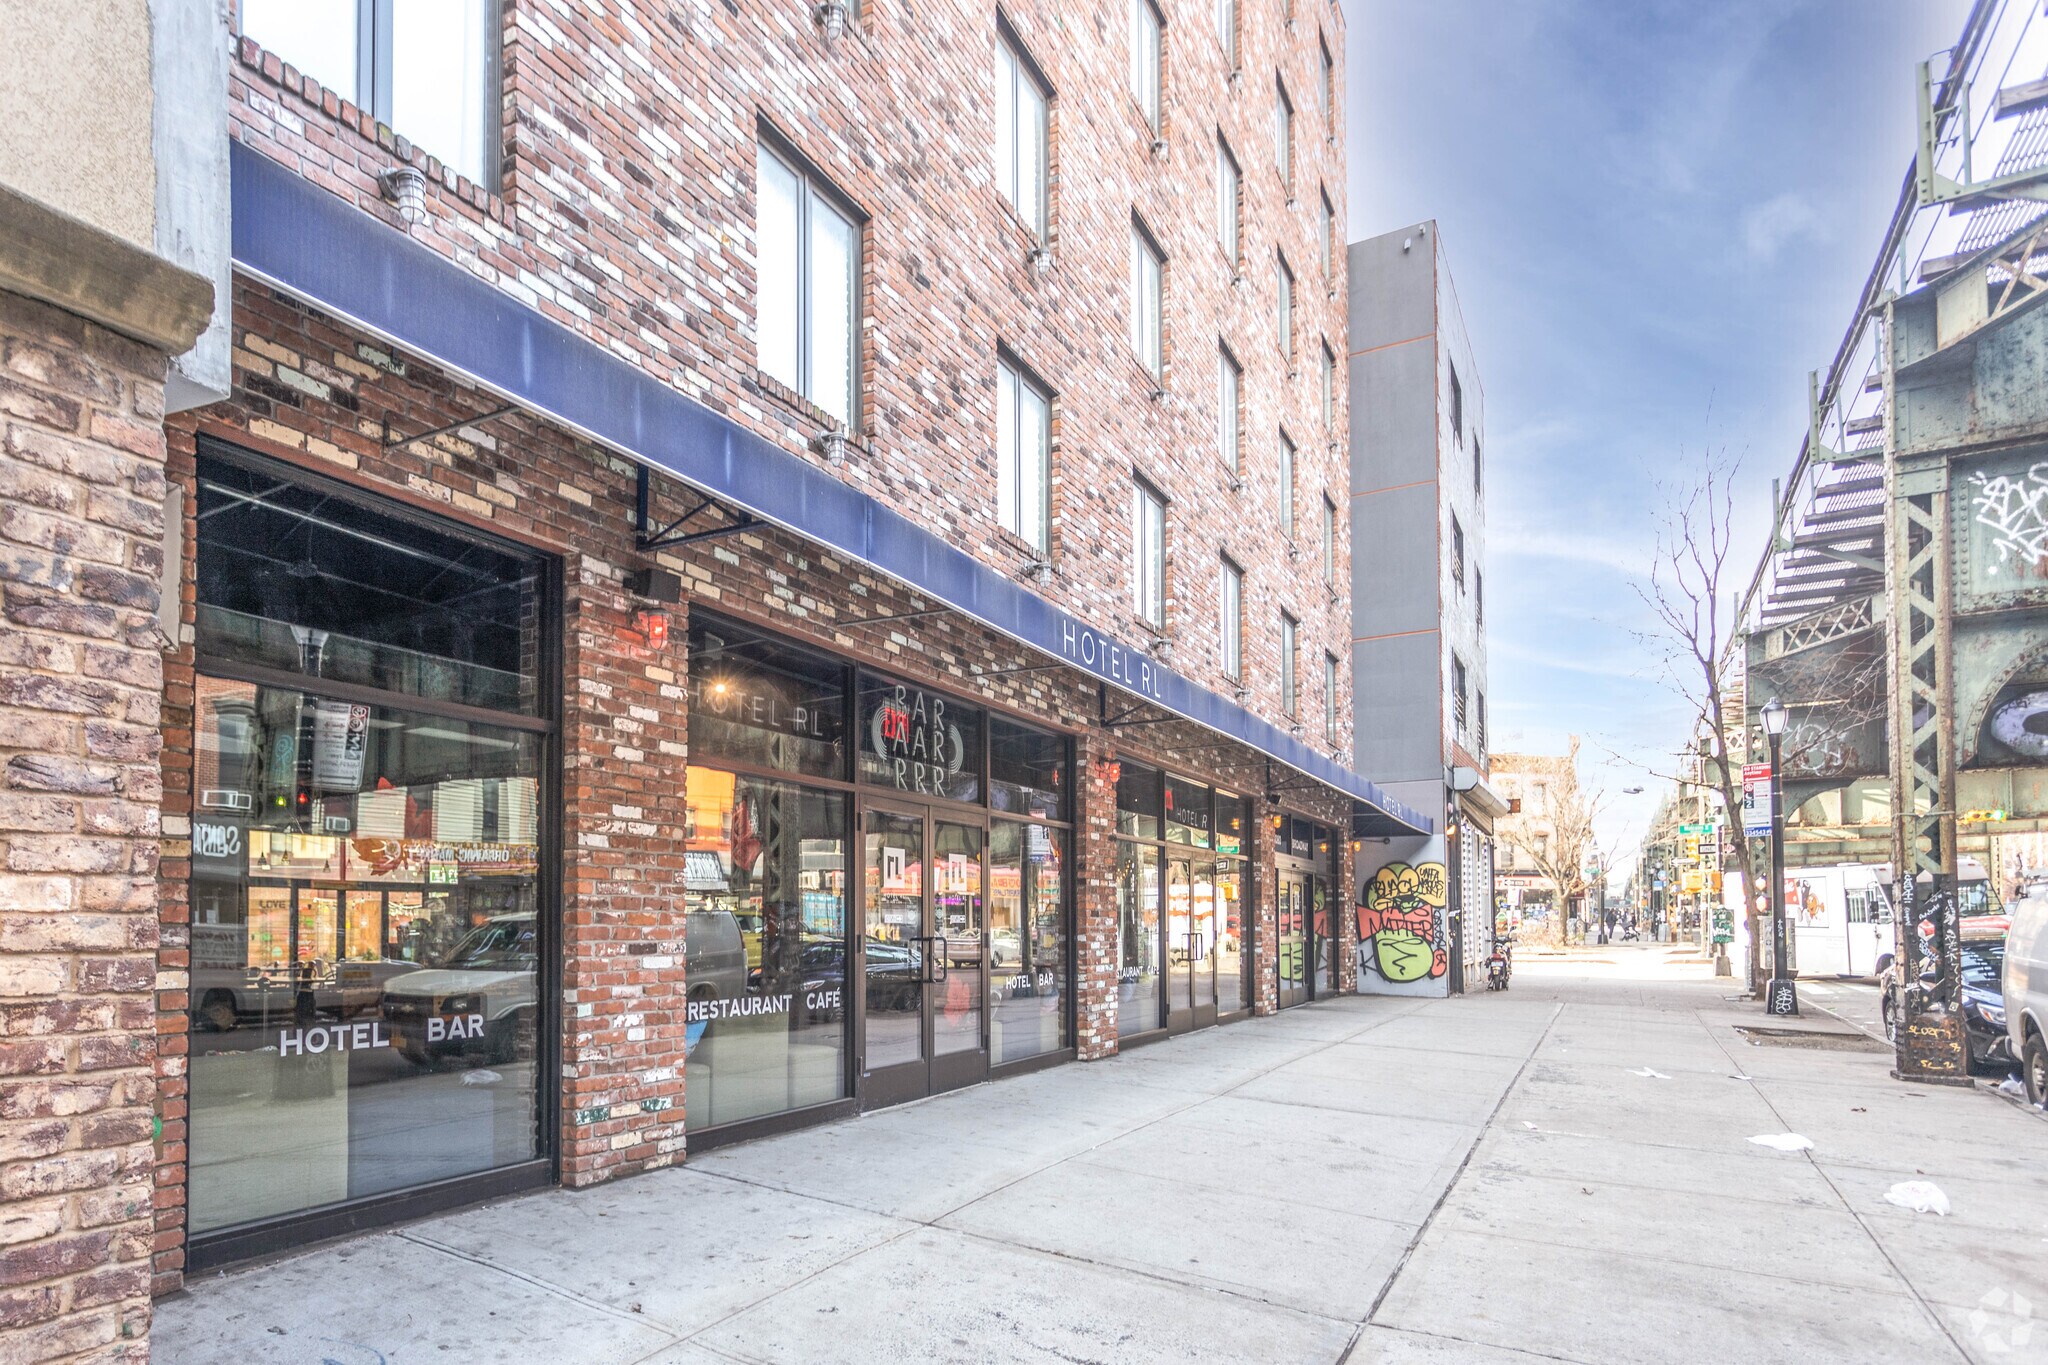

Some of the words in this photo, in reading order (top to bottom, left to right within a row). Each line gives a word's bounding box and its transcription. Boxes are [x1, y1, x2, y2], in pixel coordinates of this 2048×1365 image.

[1063, 619, 1133, 685] HOTEL
[1141, 661, 1162, 699] RL
[688, 681, 781, 727] HOTEL
[793, 706, 824, 737] RL
[1176, 806, 1198, 828] HOTEL
[1201, 813, 1208, 829] R
[1005, 973, 1031, 990] HOTEL
[1038, 972, 1054, 986] BAR
[688, 994, 793, 1021] RESTAURANT
[806, 987, 842, 1010] CAFÉ
[279, 1022, 390, 1057] HOTEL
[427, 1014, 485, 1042] BAR
